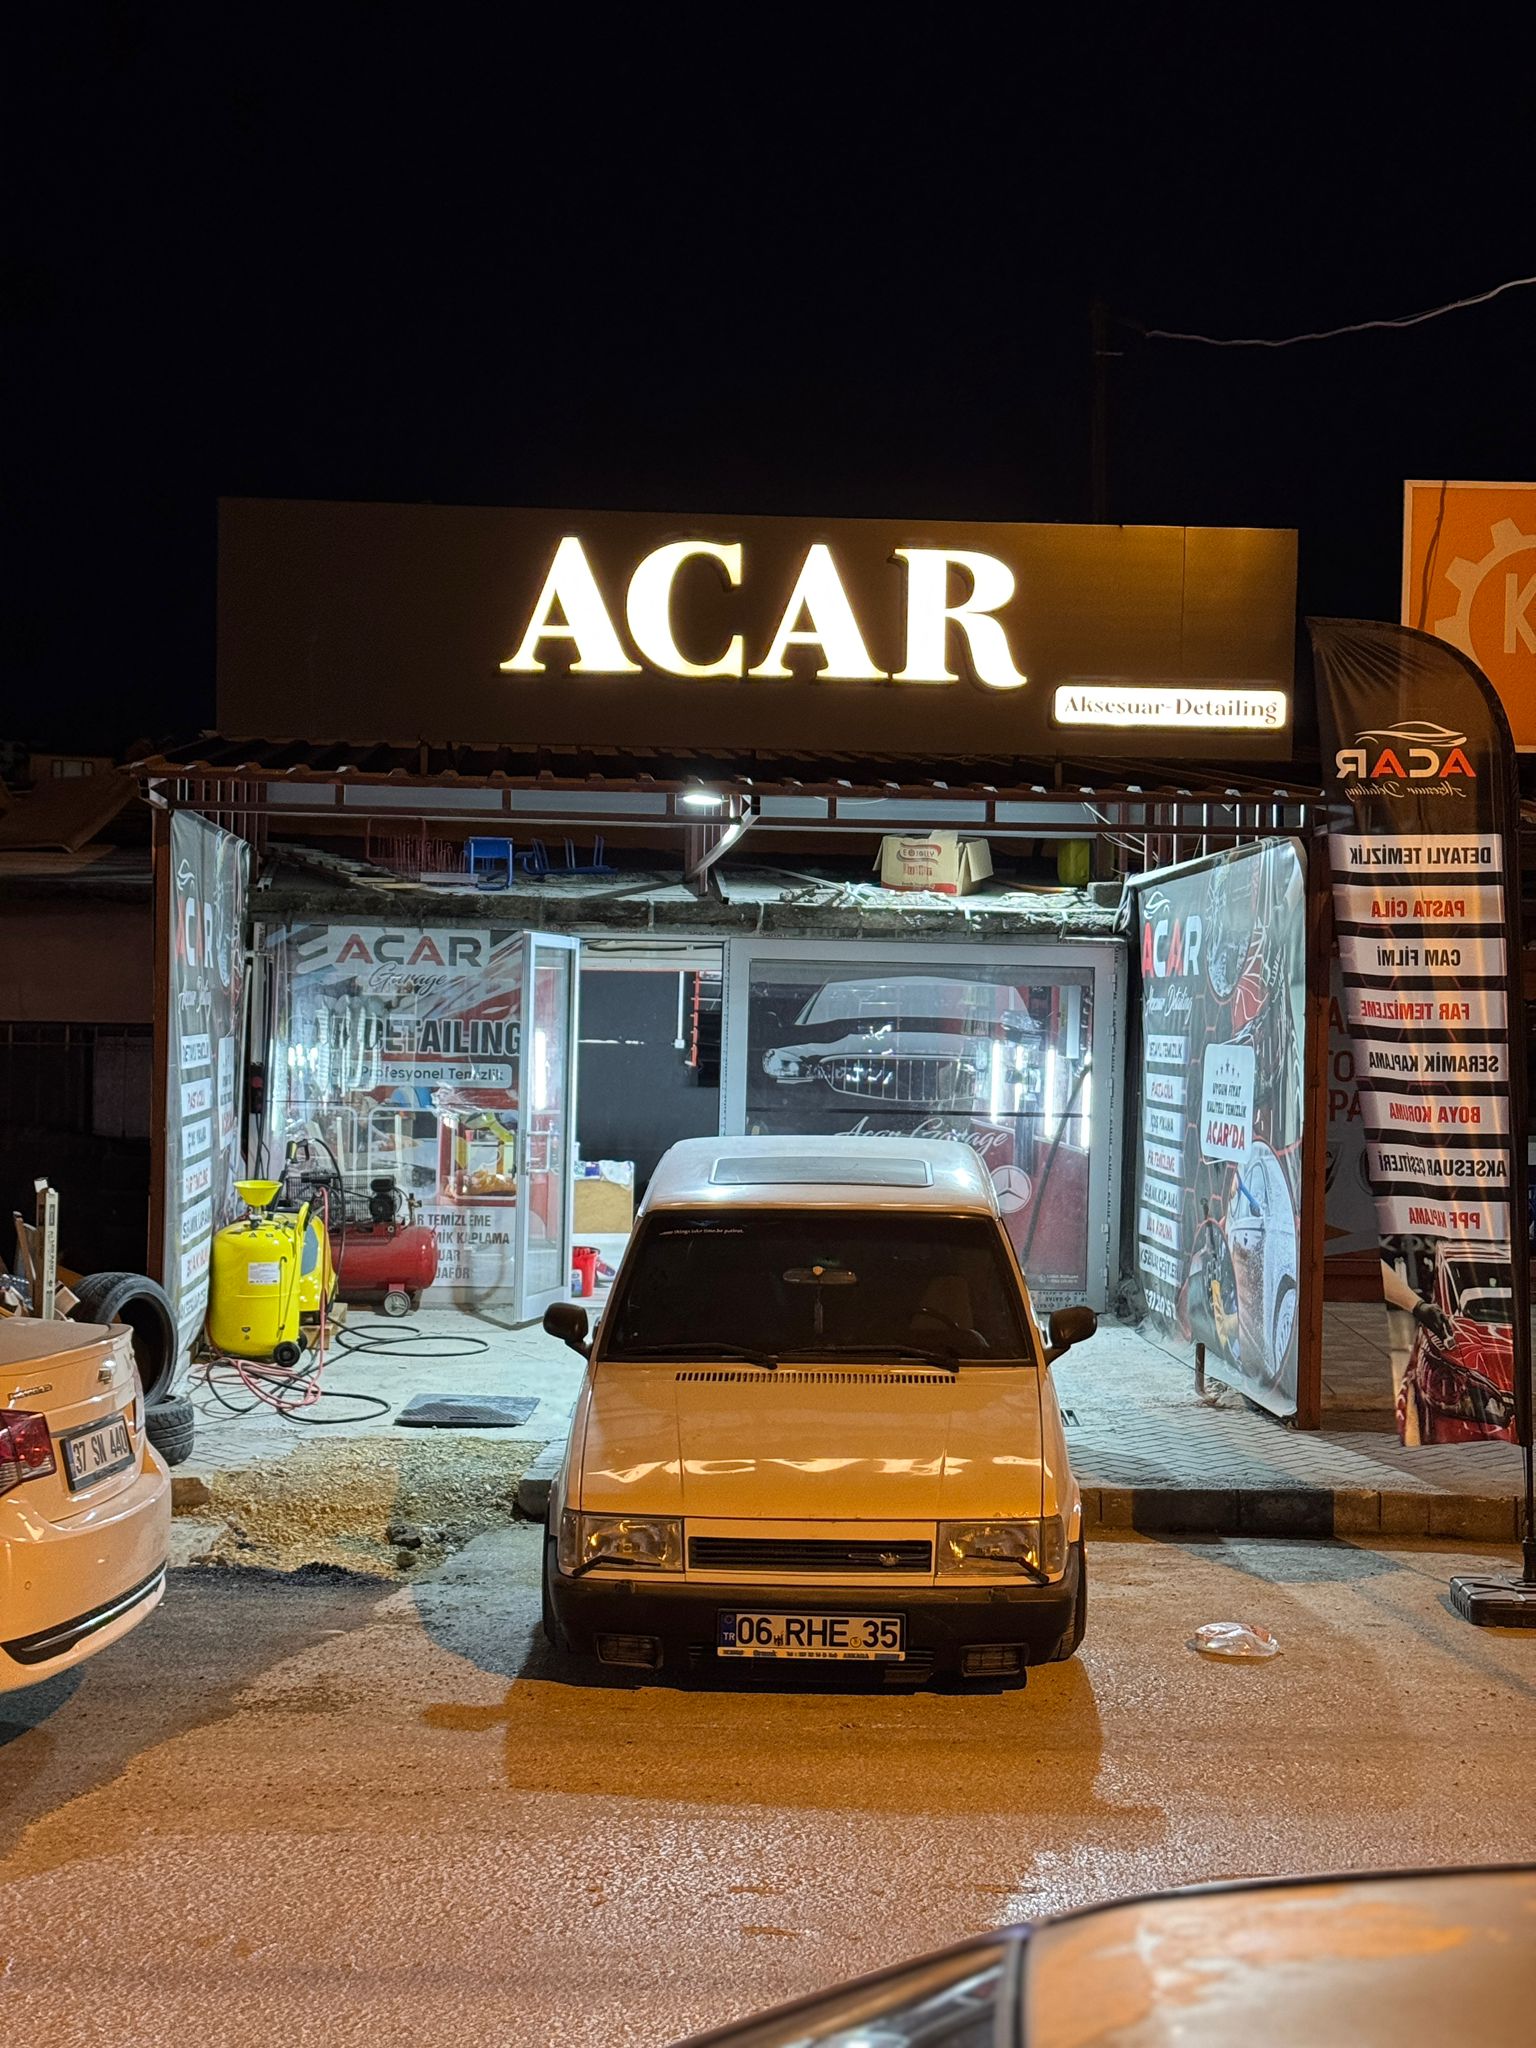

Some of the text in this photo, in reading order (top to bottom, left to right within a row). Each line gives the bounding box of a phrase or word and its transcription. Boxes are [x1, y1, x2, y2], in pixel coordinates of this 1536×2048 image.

[499, 536, 1028, 689] ACAR
[335, 933, 483, 968] ACAR
[1142, 914, 1202, 979] ACAR
[368, 961, 449, 996] Garage
[1206, 1119, 1245, 1151] ACAR'DA
[73, 1441, 87, 1474] 37
[109, 1424, 128, 1458] 440
[723, 1632, 735, 1641] TR
[737, 1617, 899, 1648] 06 RHE 35
